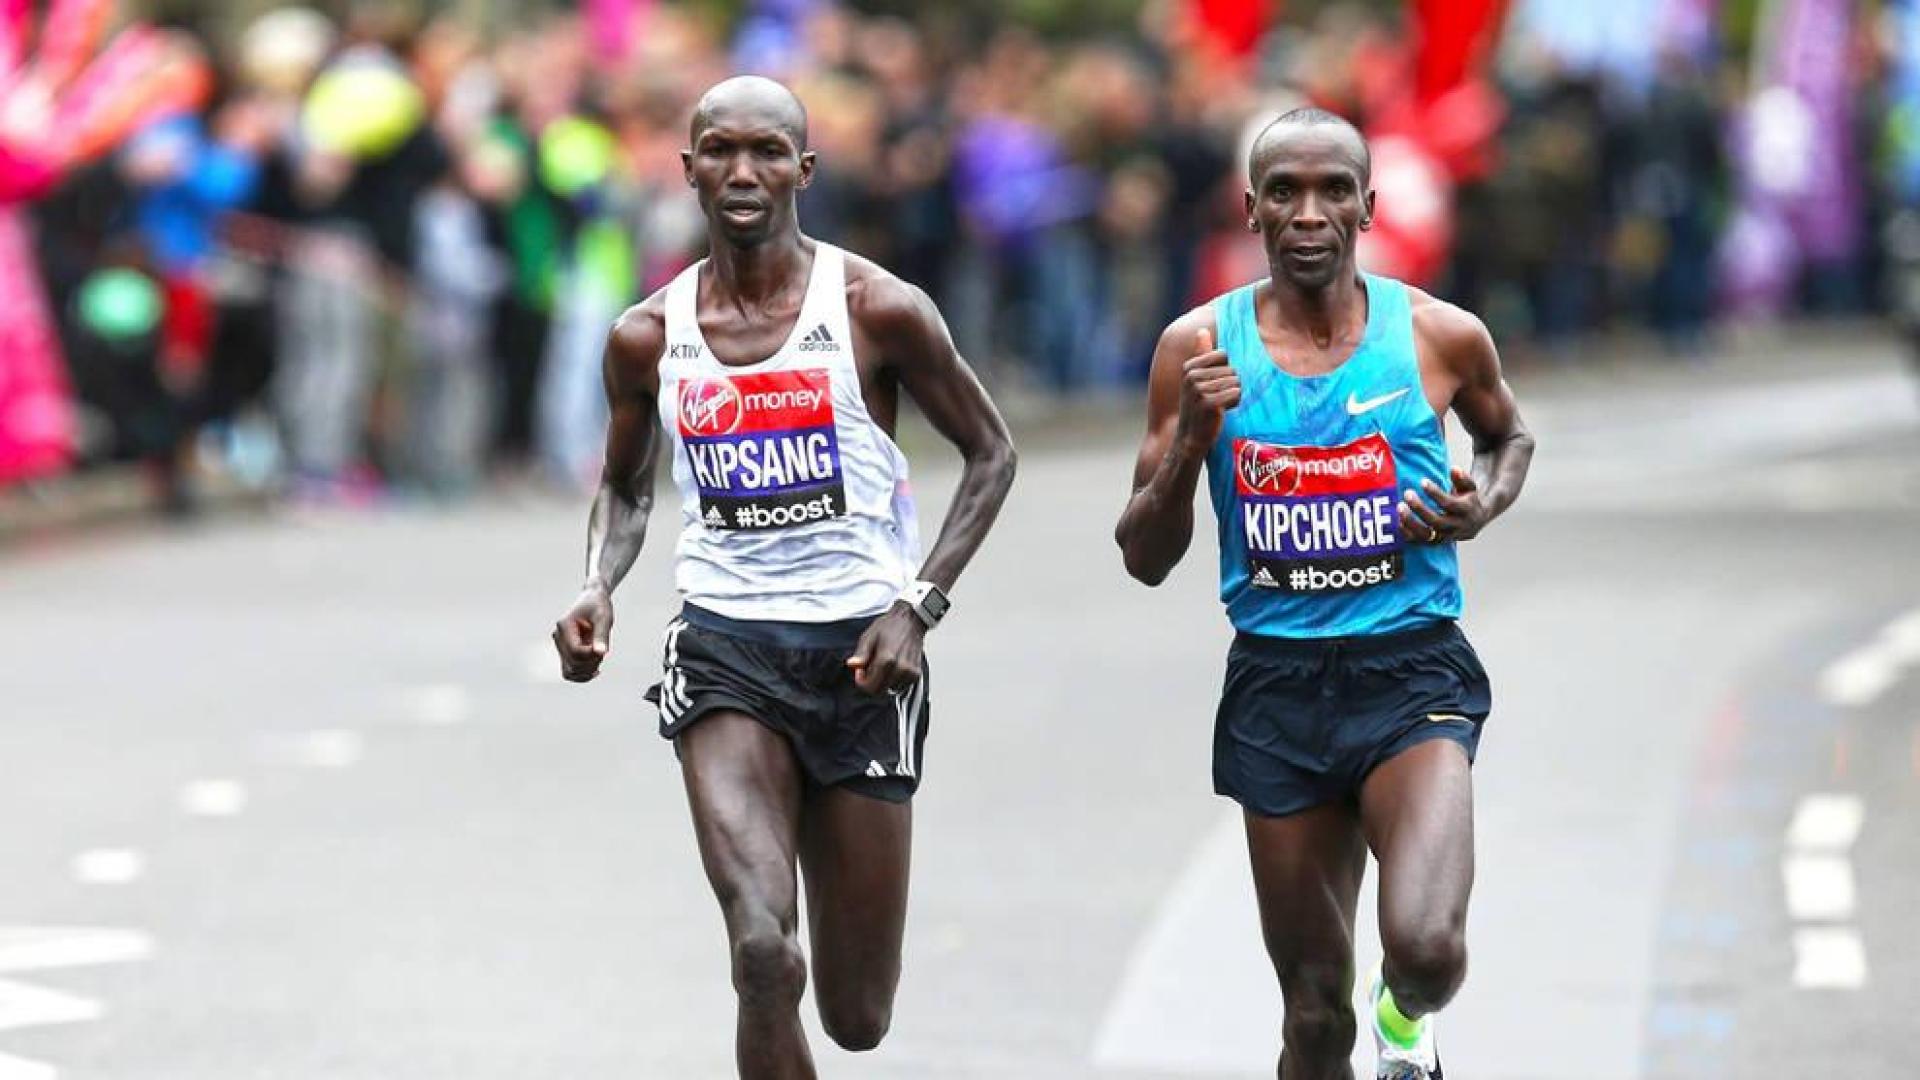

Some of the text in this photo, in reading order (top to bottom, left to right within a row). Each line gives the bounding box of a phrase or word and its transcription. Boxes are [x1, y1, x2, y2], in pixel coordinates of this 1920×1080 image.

[799, 342, 841, 352] adidas
[744, 389, 823, 411] money
[687, 433, 834, 489] KIPSANG
[1303, 451, 1384, 476] money
[735, 494, 835, 527] #boost
[1244, 496, 1395, 552] KIPCHOGE
[1289, 560, 1393, 590] #boost
